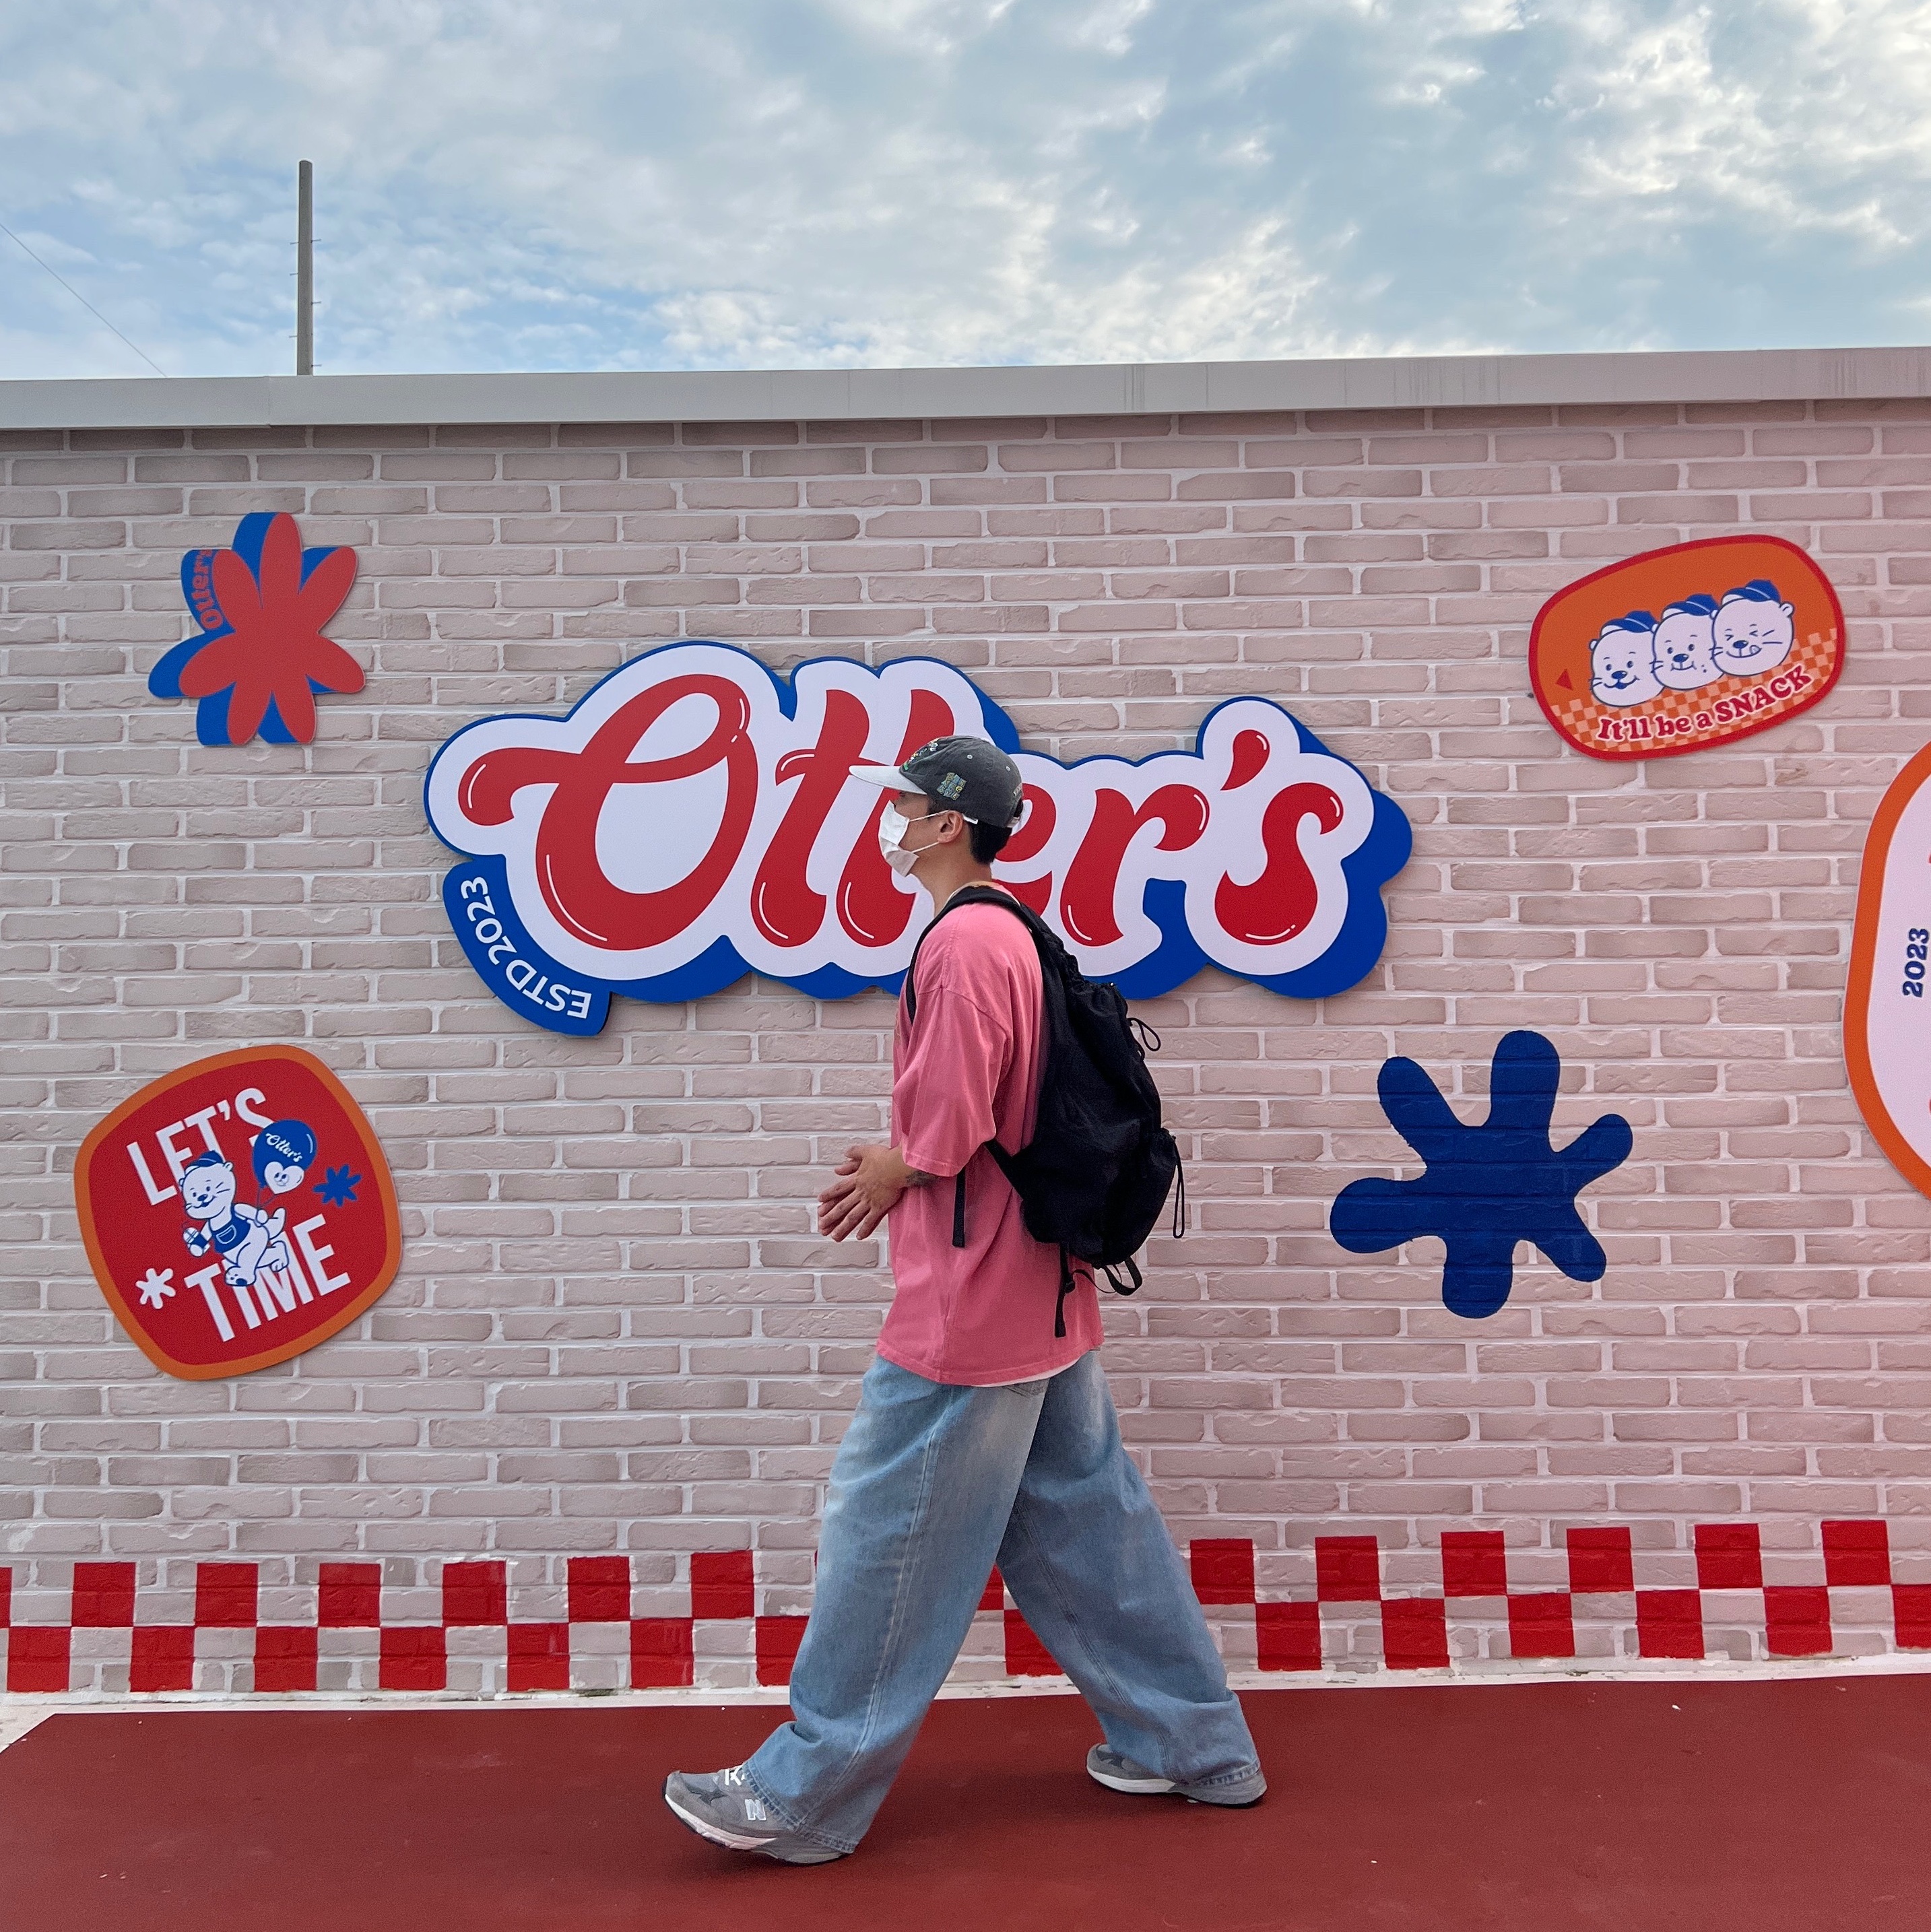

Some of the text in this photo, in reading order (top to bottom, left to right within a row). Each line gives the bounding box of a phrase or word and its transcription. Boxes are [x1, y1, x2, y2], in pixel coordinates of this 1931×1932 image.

[1598, 663, 1812, 740] It'll be a SNACK
[460, 876, 592, 1019] ESTD 2023
[1902, 928, 1930, 998] 2023
[265, 1133, 303, 1163] Otter's
[183, 1213, 352, 1343] TIME
